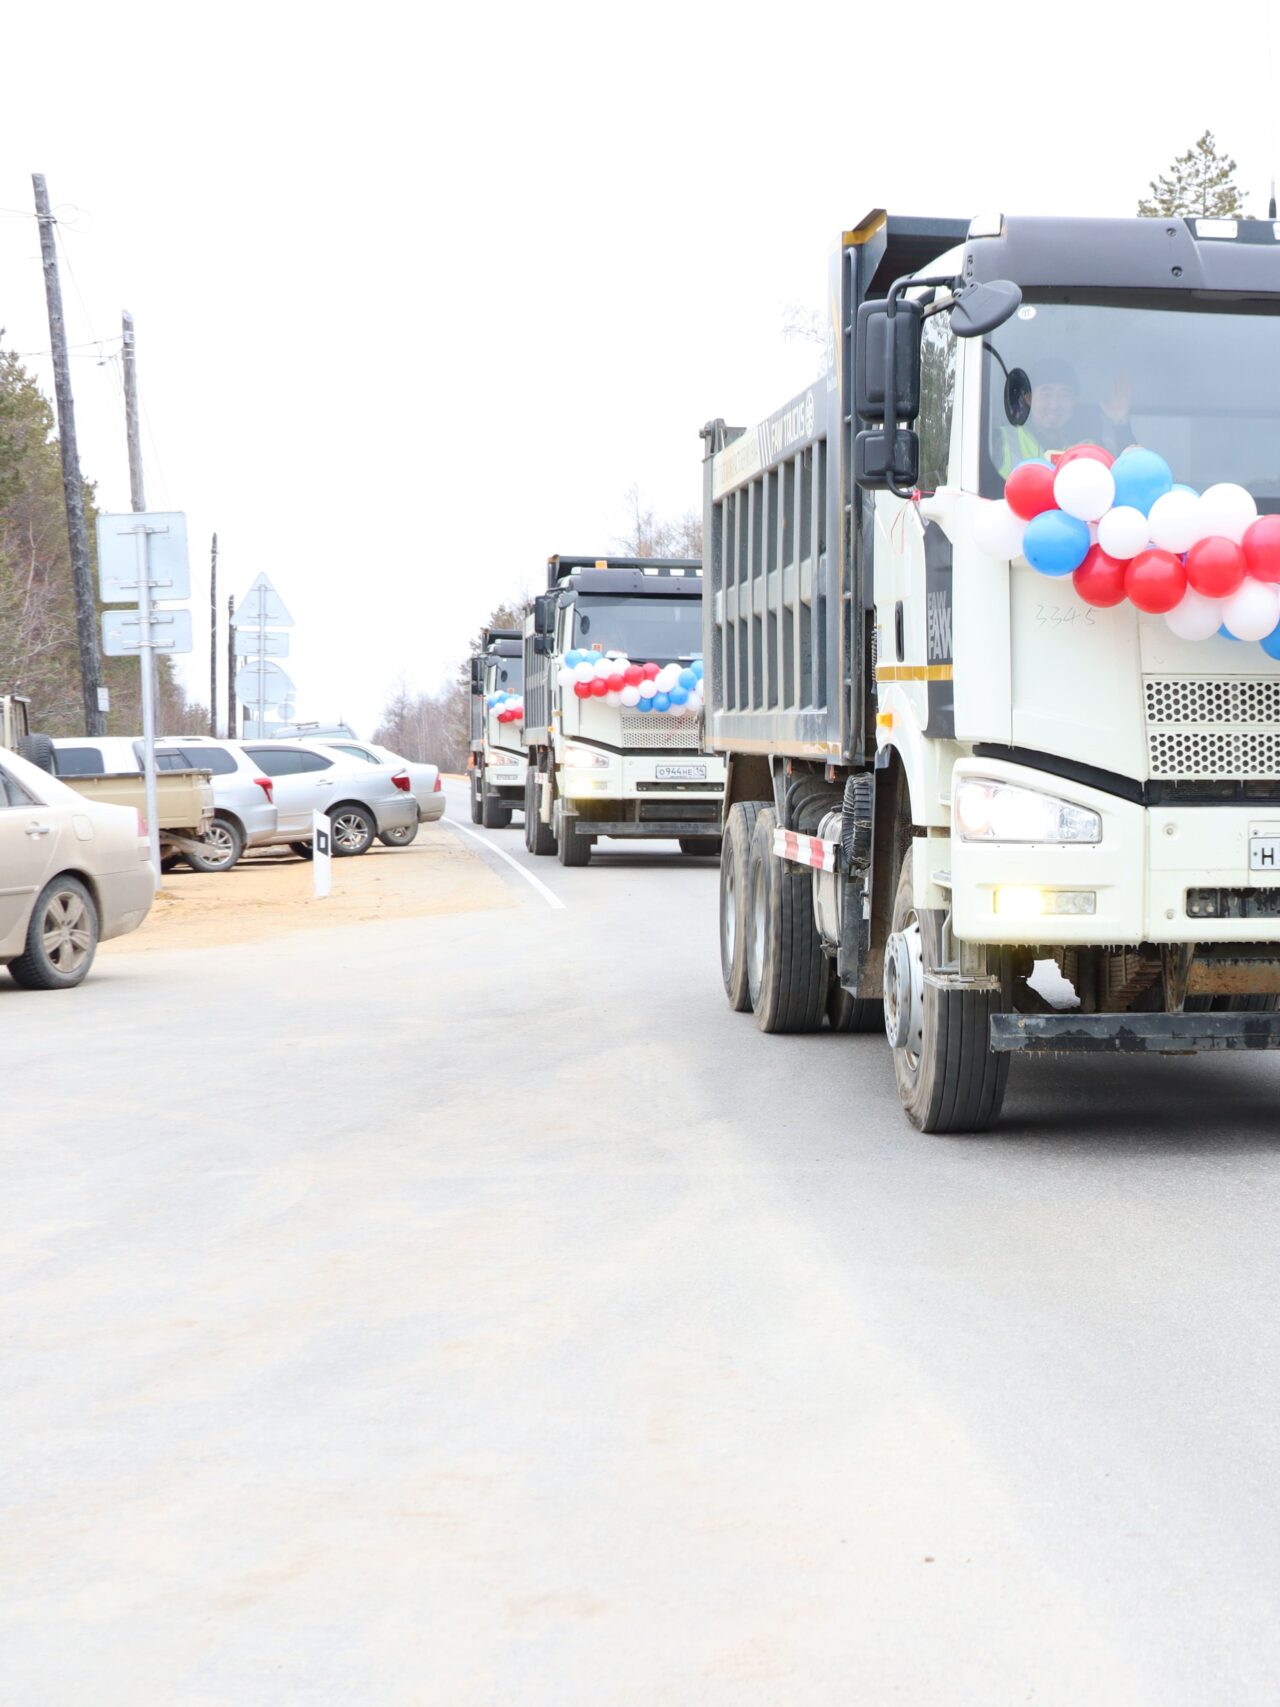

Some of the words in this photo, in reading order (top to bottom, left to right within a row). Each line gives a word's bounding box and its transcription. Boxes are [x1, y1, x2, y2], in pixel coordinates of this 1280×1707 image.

[927, 591, 947, 609] FAW
[928, 607, 951, 633] FAW
[928, 631, 953, 660] FAW
